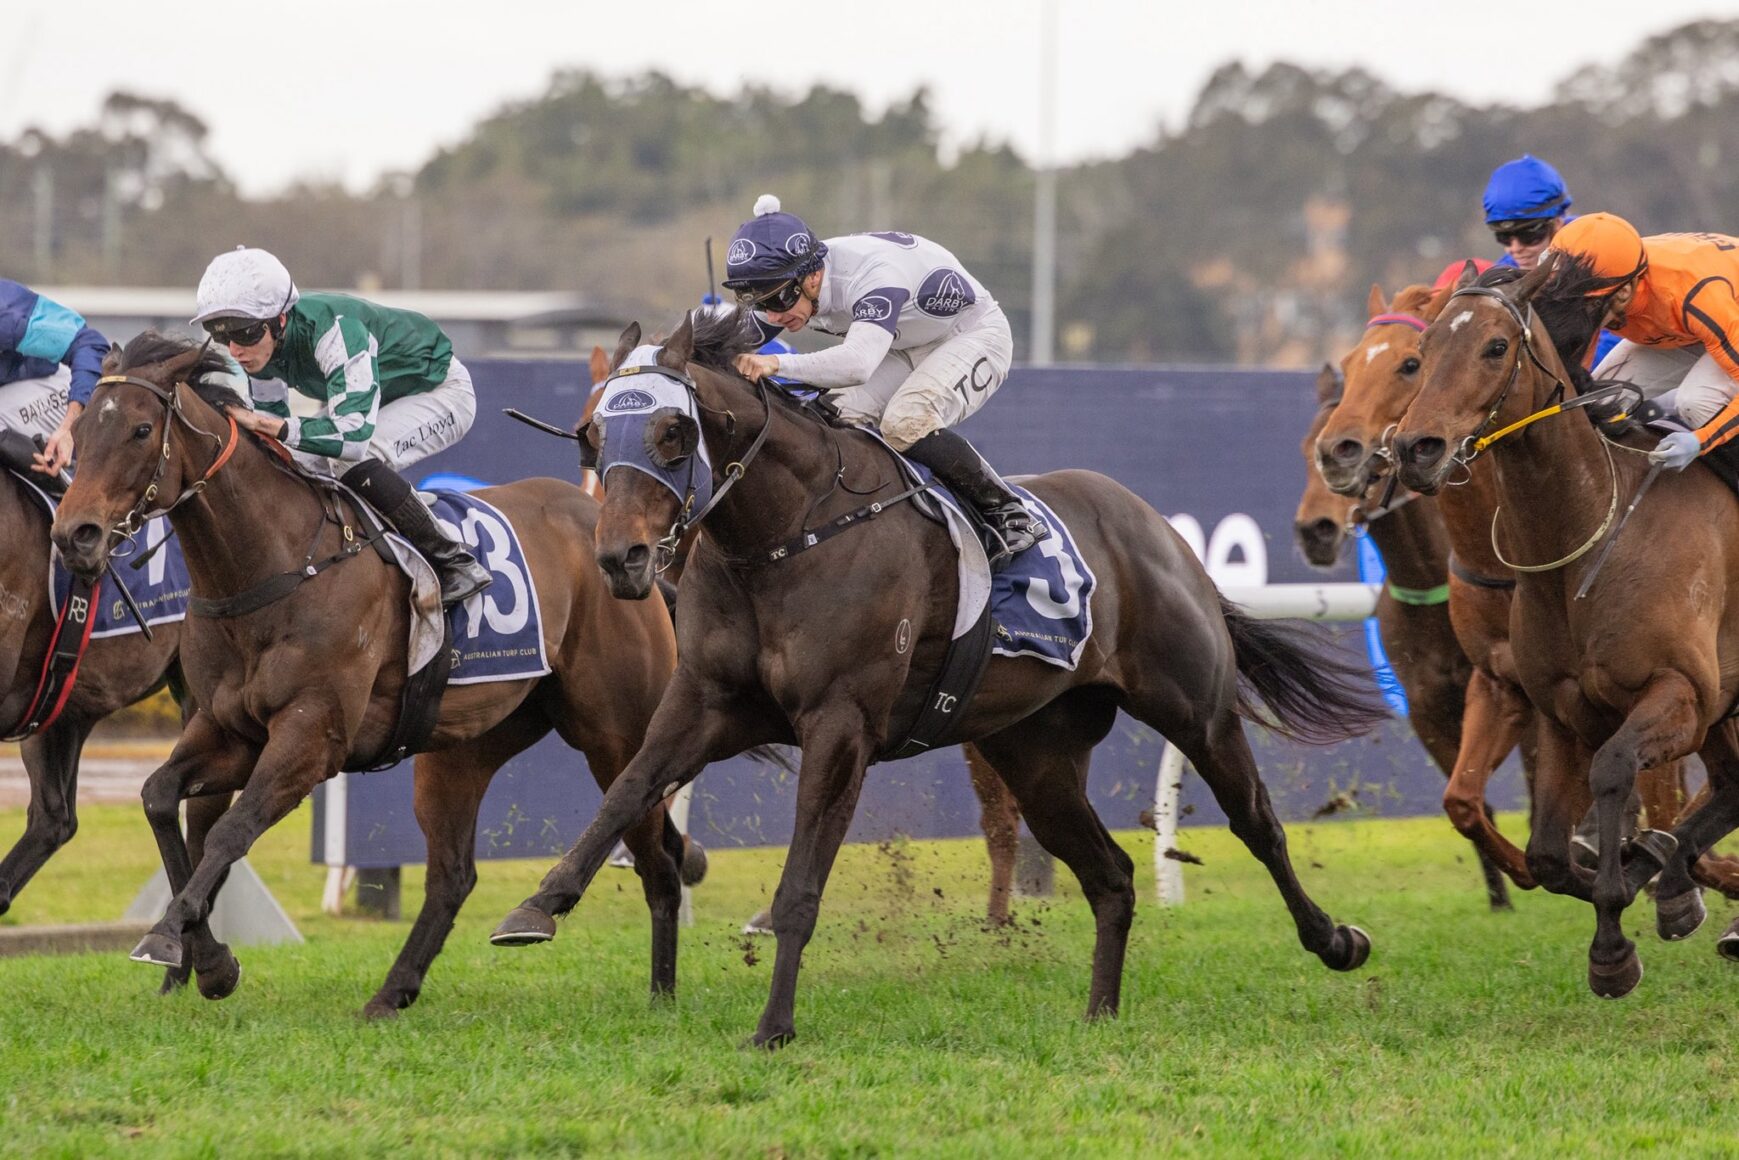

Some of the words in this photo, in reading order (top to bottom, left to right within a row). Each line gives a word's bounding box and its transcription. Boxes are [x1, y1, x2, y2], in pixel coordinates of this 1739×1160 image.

[854, 308, 884, 320] ARBY
[926, 297, 968, 309] DARBY
[953, 356, 993, 405] TC
[393, 436, 417, 458] Zac
[418, 411, 455, 442] Lloyd
[770, 548, 786, 560] TC
[1021, 500, 1084, 619] 3
[68, 595, 88, 623] RB
[463, 649, 502, 660] AUSTRALIAN
[502, 648, 518, 657] TURF
[519, 647, 537, 656] CLUB
[934, 691, 957, 713] TC
